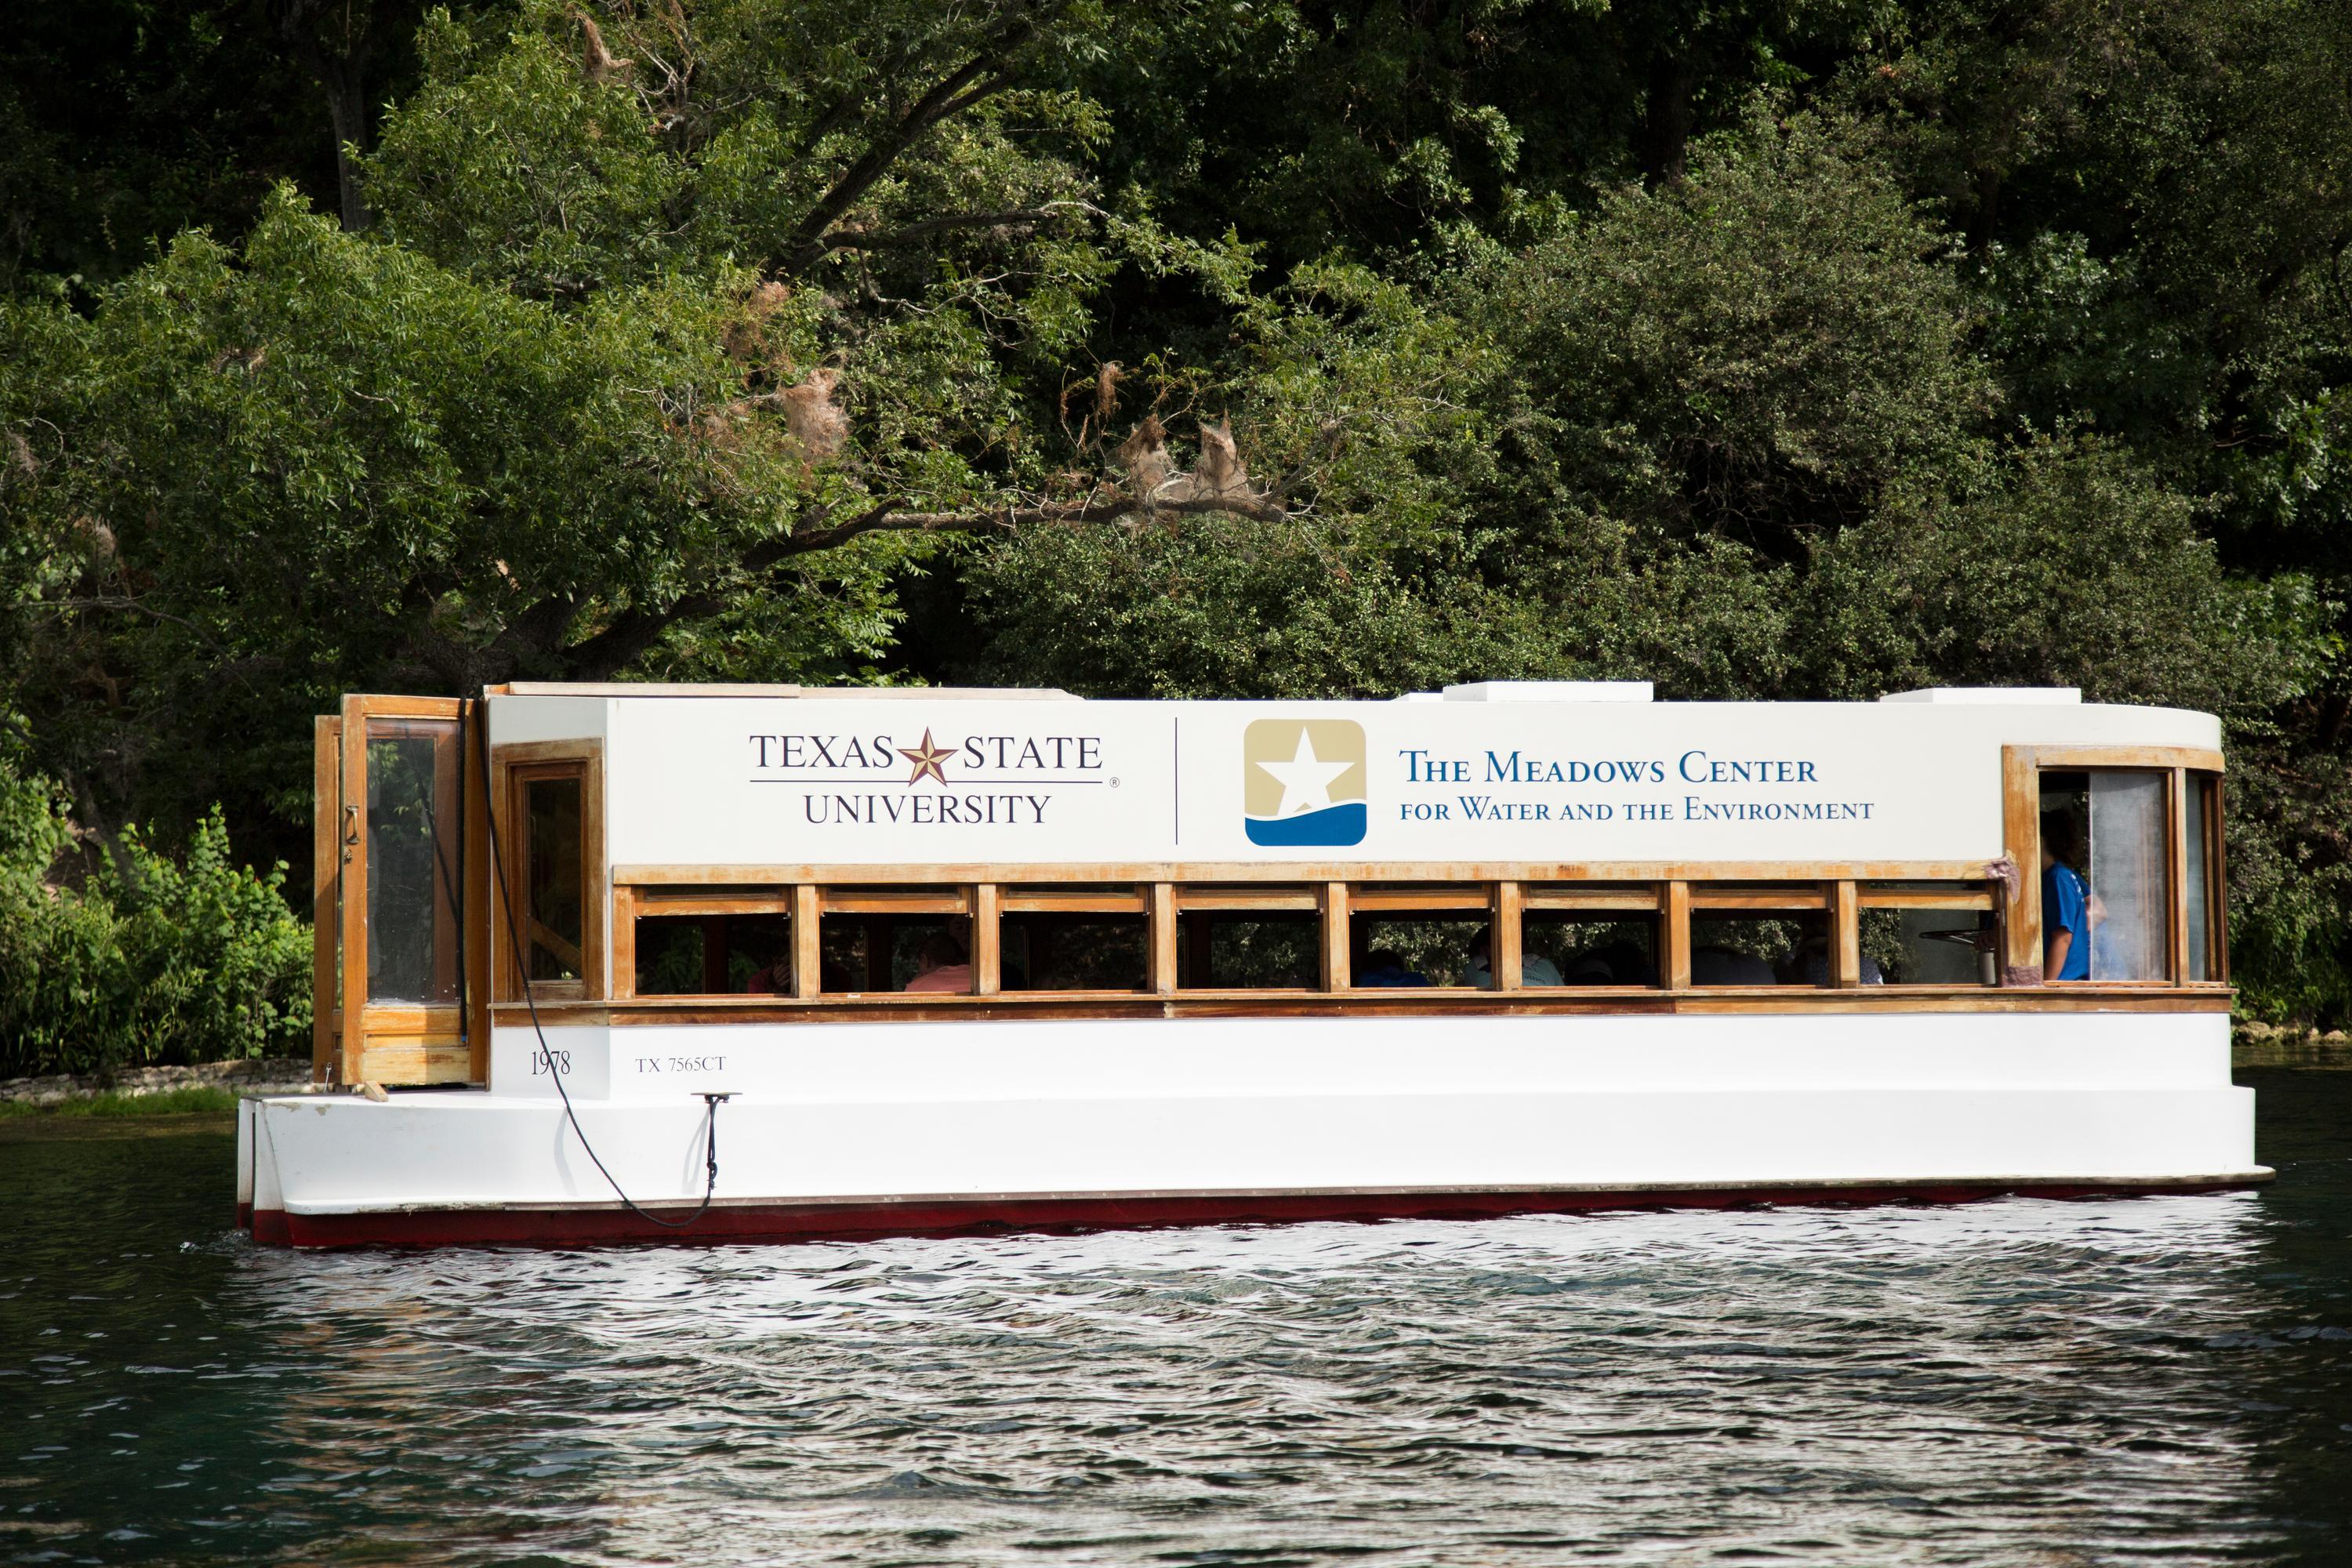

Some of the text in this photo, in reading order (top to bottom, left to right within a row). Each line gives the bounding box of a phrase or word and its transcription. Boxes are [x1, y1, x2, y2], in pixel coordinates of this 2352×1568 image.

[749, 735, 1102, 769] TEXAS STATE
[1399, 750, 1818, 783] THE MEADOWS CENTER
[803, 794, 1051, 824] UNIVERSITY
[1400, 796, 1875, 821] FOR WATER AND THE ENVIRONMENT
[531, 1050, 571, 1076] 1978
[635, 1056, 727, 1073] TX 7565CT
